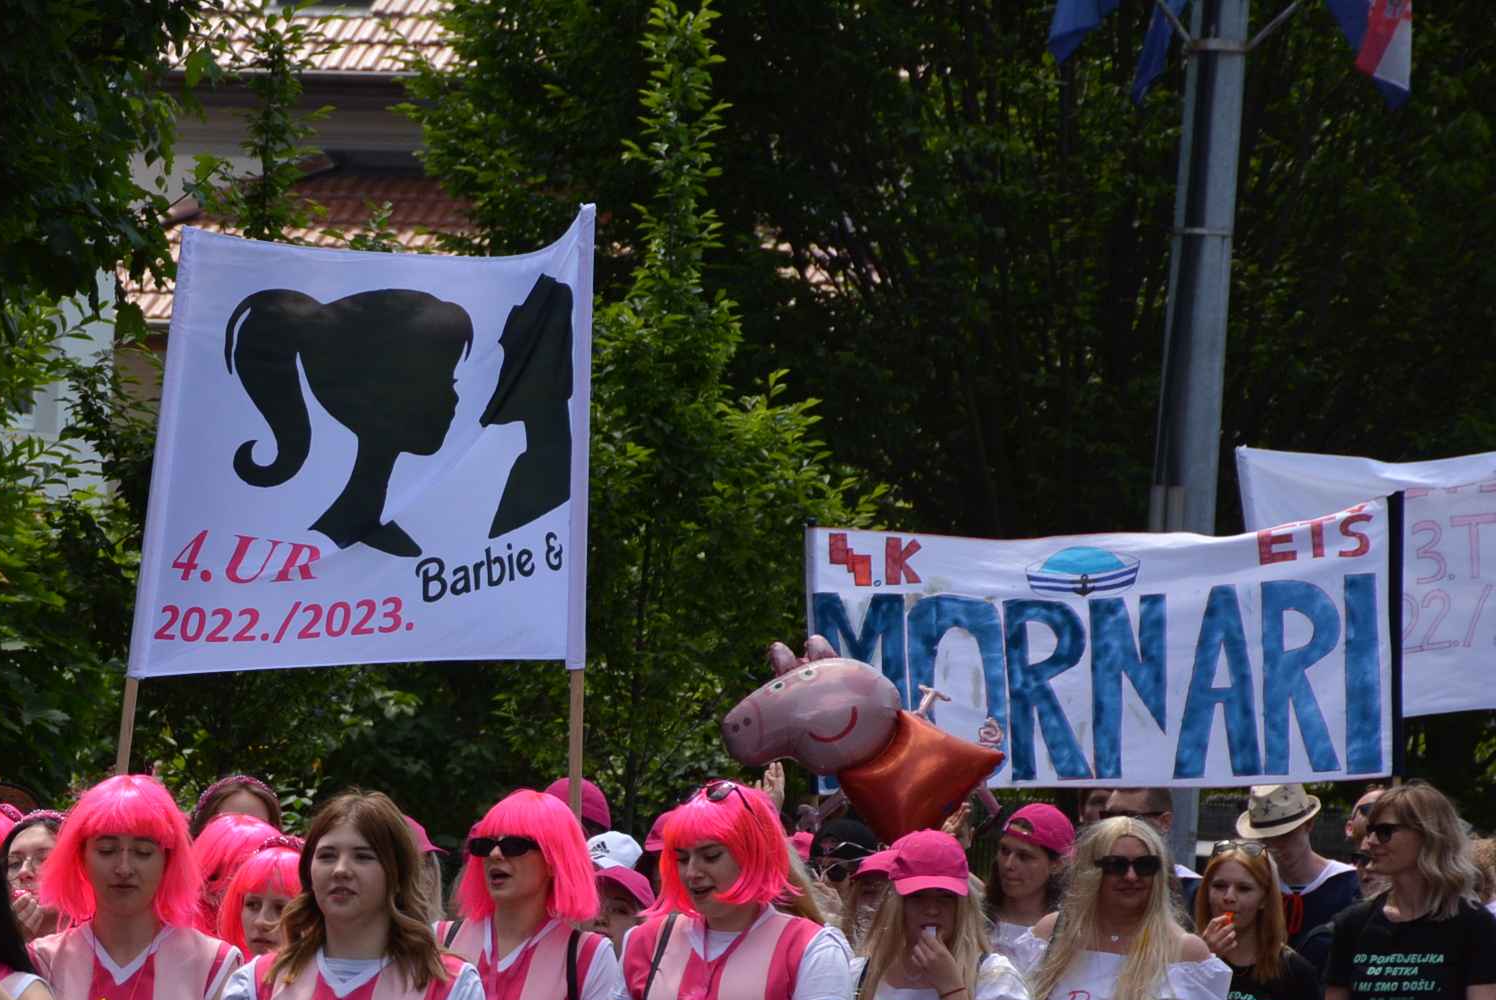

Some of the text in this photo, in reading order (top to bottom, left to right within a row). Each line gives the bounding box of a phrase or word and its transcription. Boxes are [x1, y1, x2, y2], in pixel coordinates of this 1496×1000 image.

[171, 529, 322, 585] 4.UR
[415, 531, 564, 603] Barbie &
[153, 596, 416, 645] 2022./2023.
[811, 573, 1383, 793] MORNARI
[1374, 981, 1400, 992] SMO
